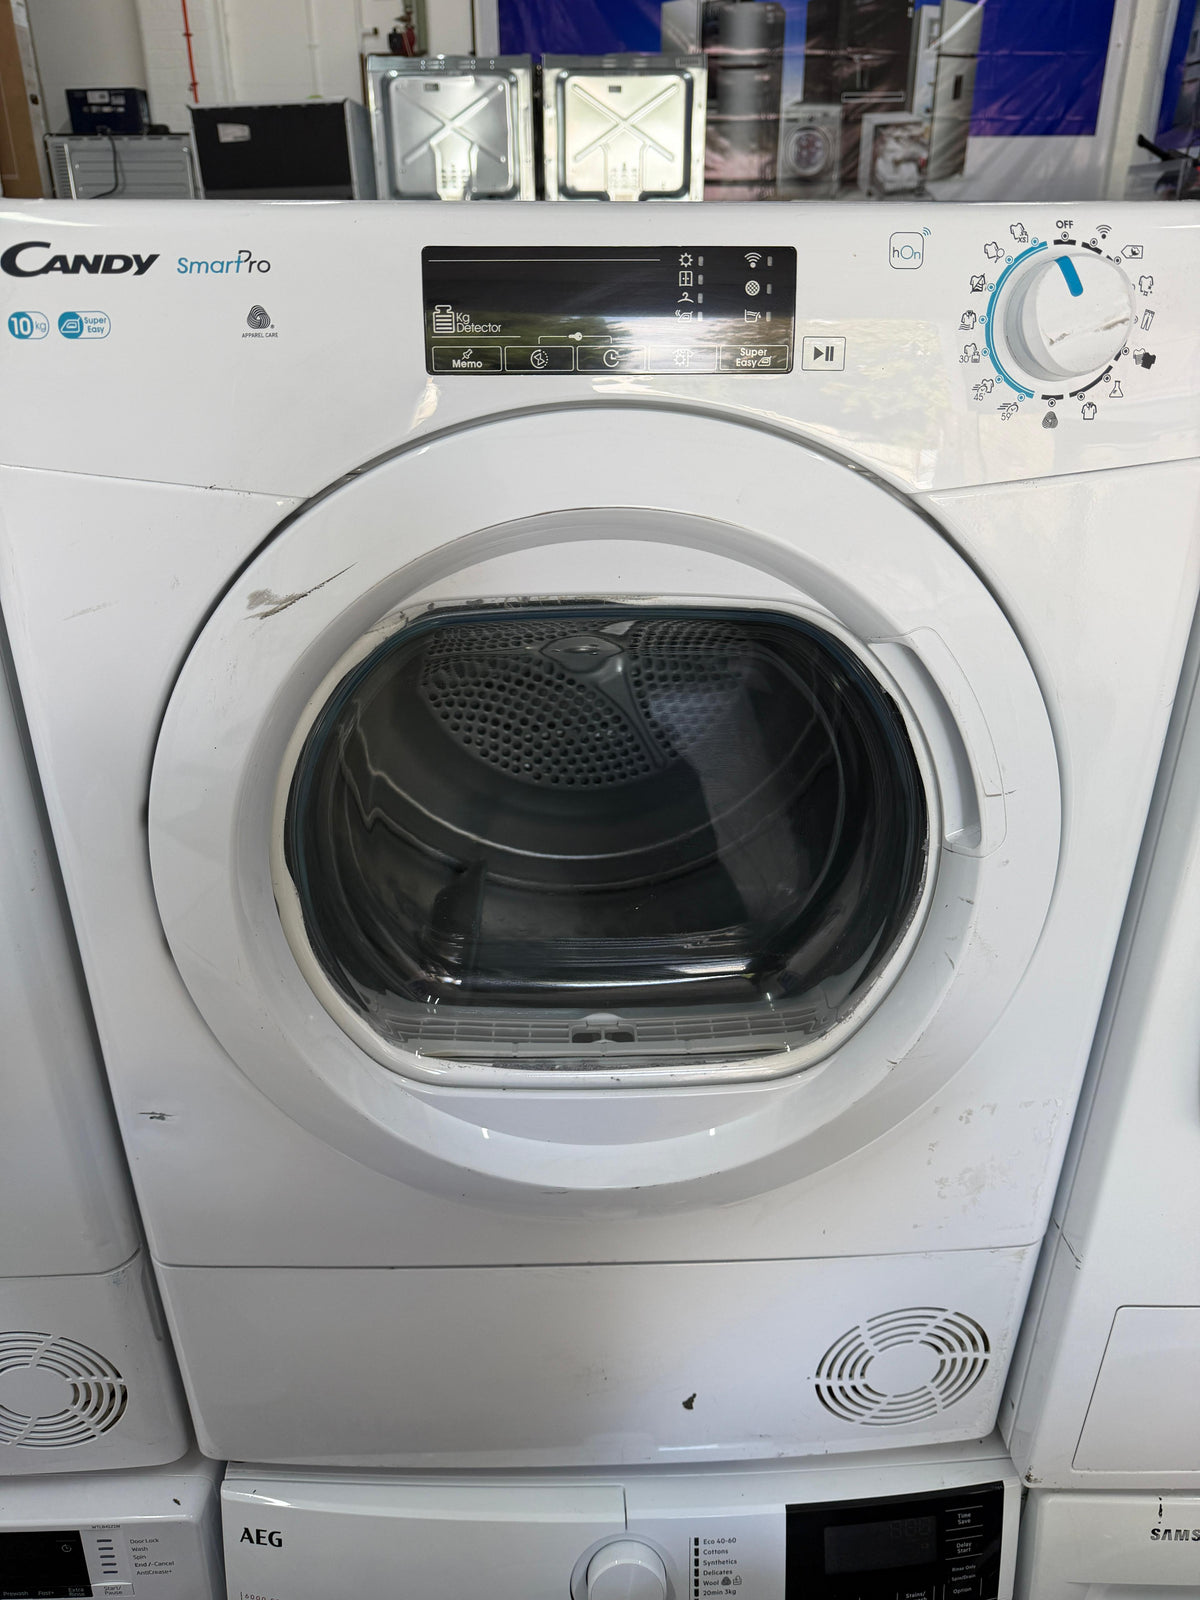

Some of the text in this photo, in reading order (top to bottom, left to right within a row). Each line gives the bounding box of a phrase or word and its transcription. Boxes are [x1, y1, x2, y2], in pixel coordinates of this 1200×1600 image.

[1055, 220, 1074, 229] OFF
[892, 245, 921, 260] hOn
[0, 241, 160, 278] CANDY
[83, 316, 107, 325] Super
[456, 312, 470, 325] Kg
[10, 316, 47, 336] 10 kg
[87, 325, 105, 334] Easy
[456, 322, 502, 333] Detector
[739, 347, 768, 358] Super
[452, 359, 483, 368] Memo
[735, 357, 758, 368] Easy
[240, 1527, 282, 1548] AEG
[1150, 1528, 1200, 1541] SAMS
[702, 1559, 738, 1567] Synthetics
[905, 1591, 926, 1599] Stains/
[952, 1587, 972, 1595] Option
